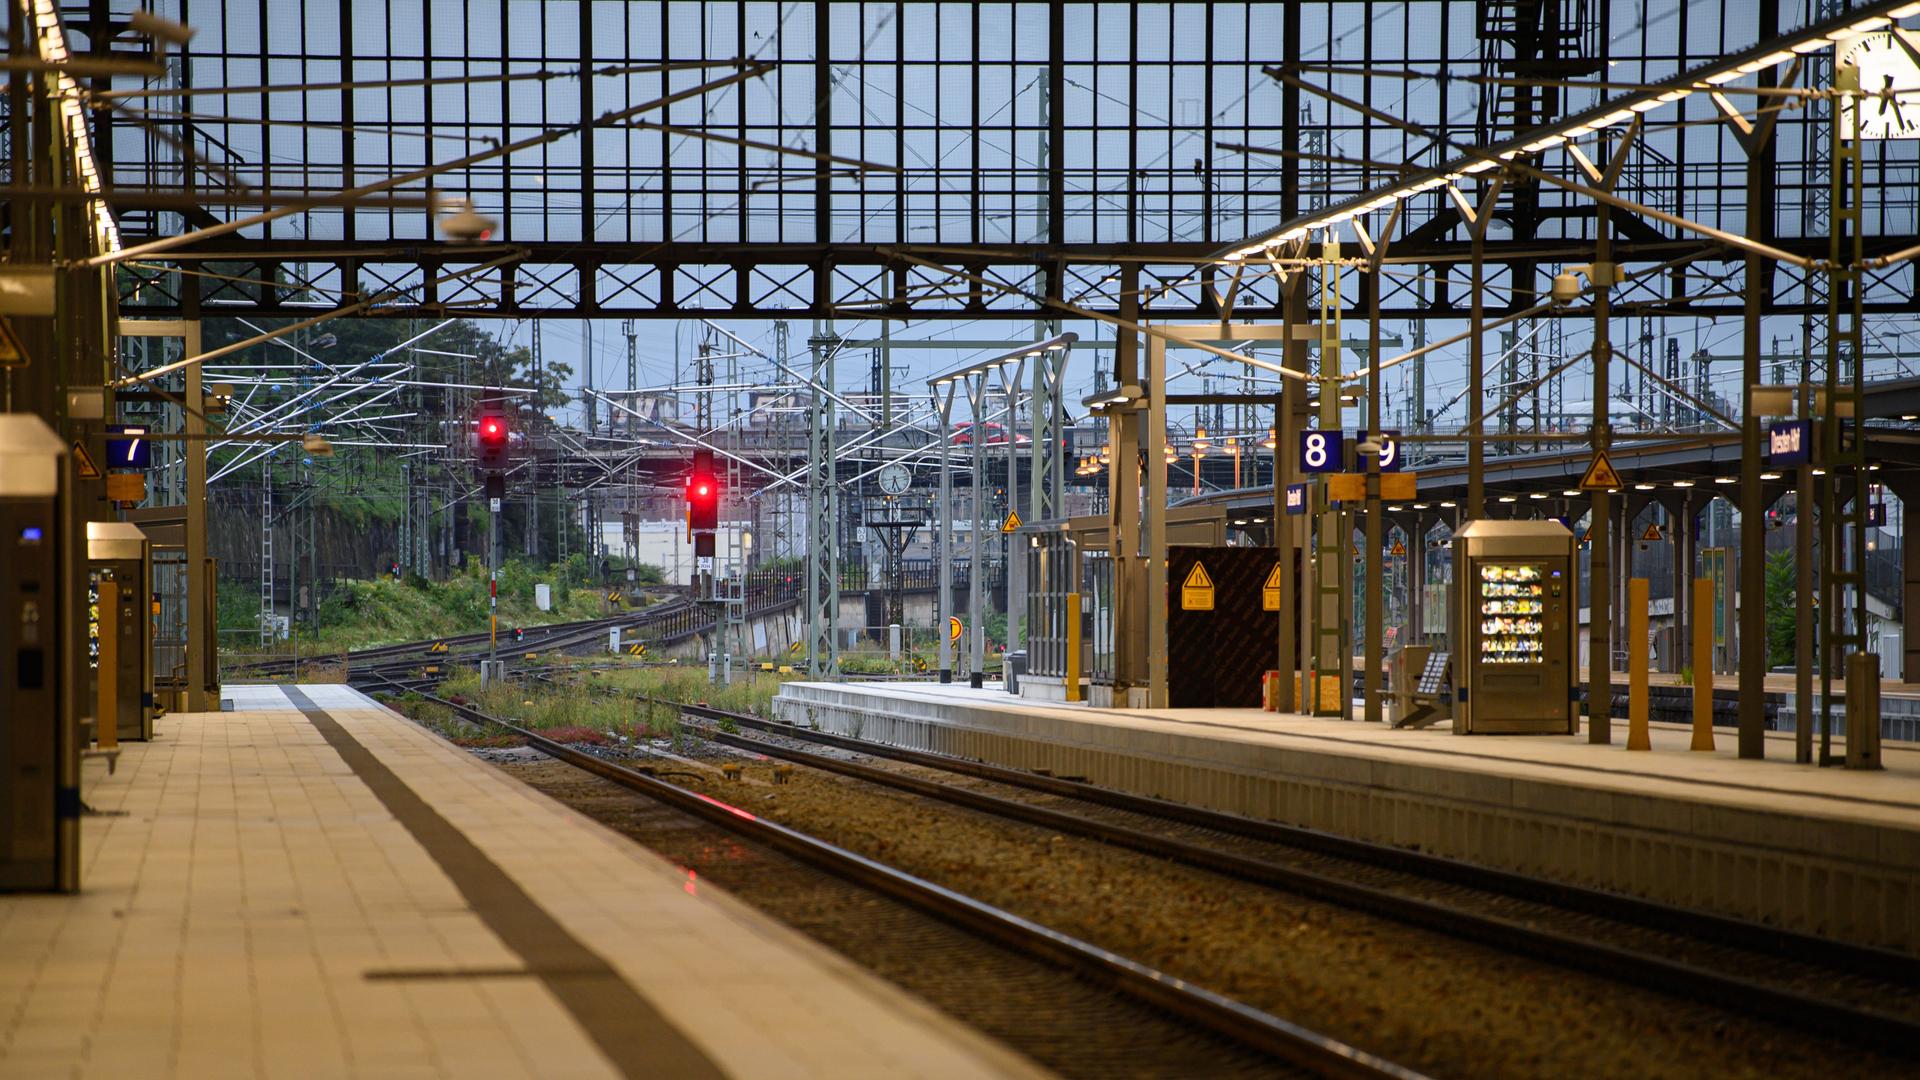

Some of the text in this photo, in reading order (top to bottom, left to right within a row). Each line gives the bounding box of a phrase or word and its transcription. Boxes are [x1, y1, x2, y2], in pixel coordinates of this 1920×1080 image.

[124, 429, 145, 461] 7
[1305, 433, 1327, 467] 8
[1379, 433, 1395, 467] 9
